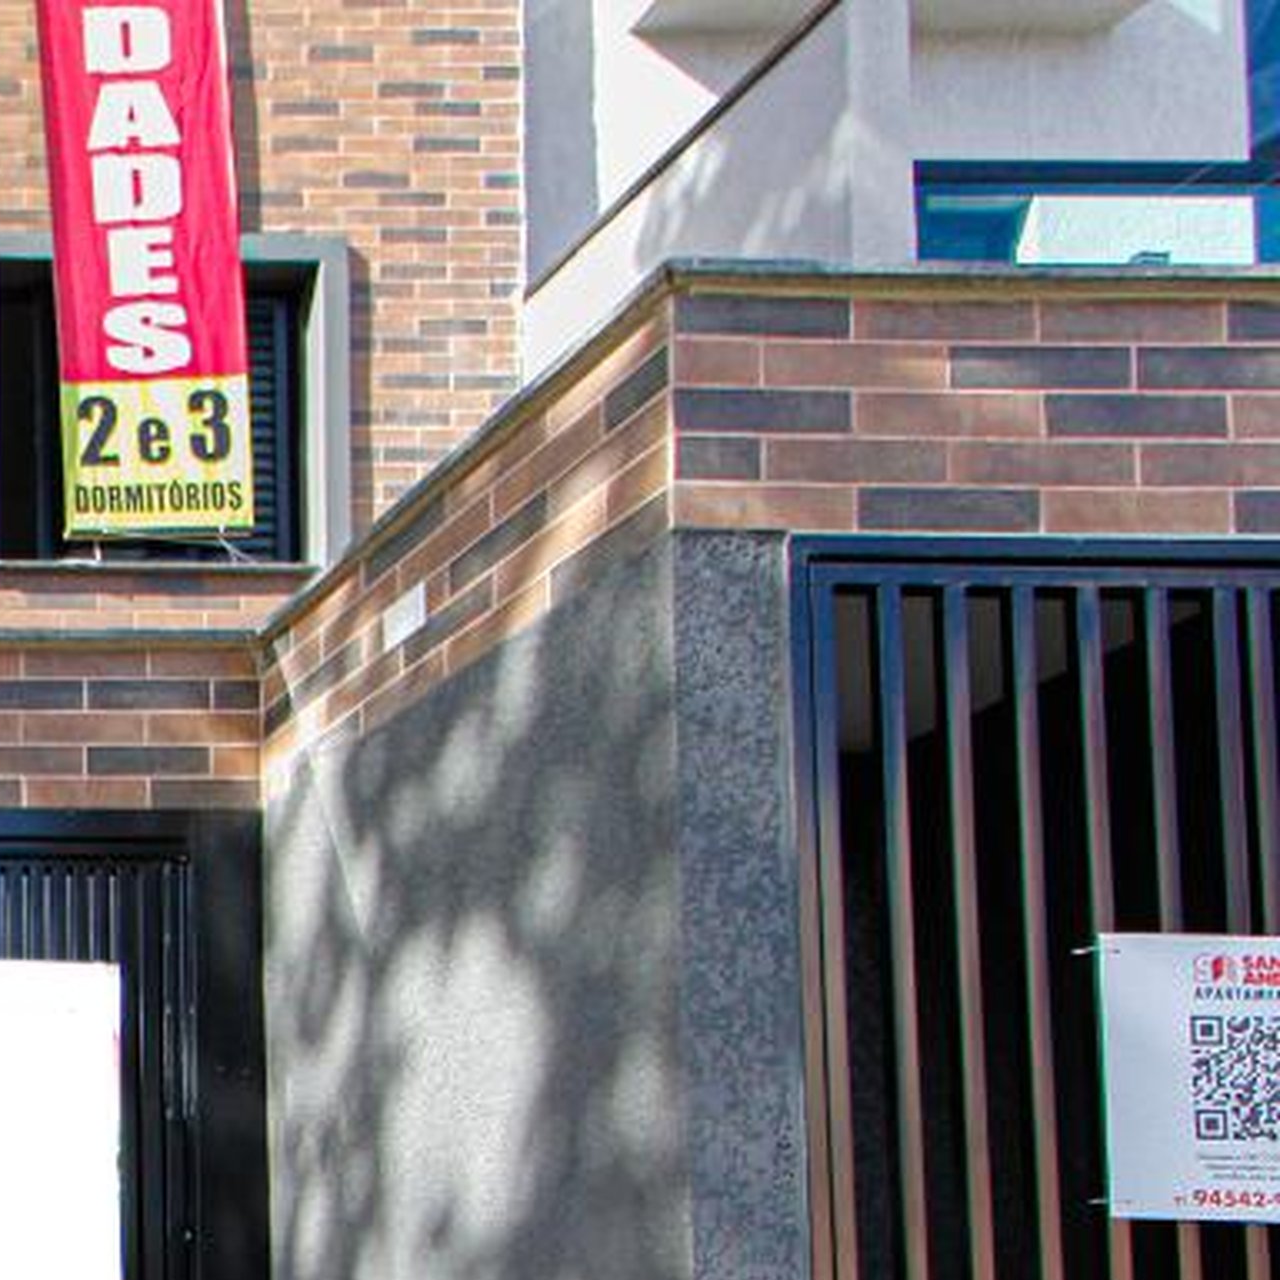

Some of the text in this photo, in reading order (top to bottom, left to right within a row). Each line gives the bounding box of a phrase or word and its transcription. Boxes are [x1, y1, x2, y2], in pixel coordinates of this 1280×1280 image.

[82, 6, 192, 373] DADES
[77, 390, 232, 467] 2 e 3
